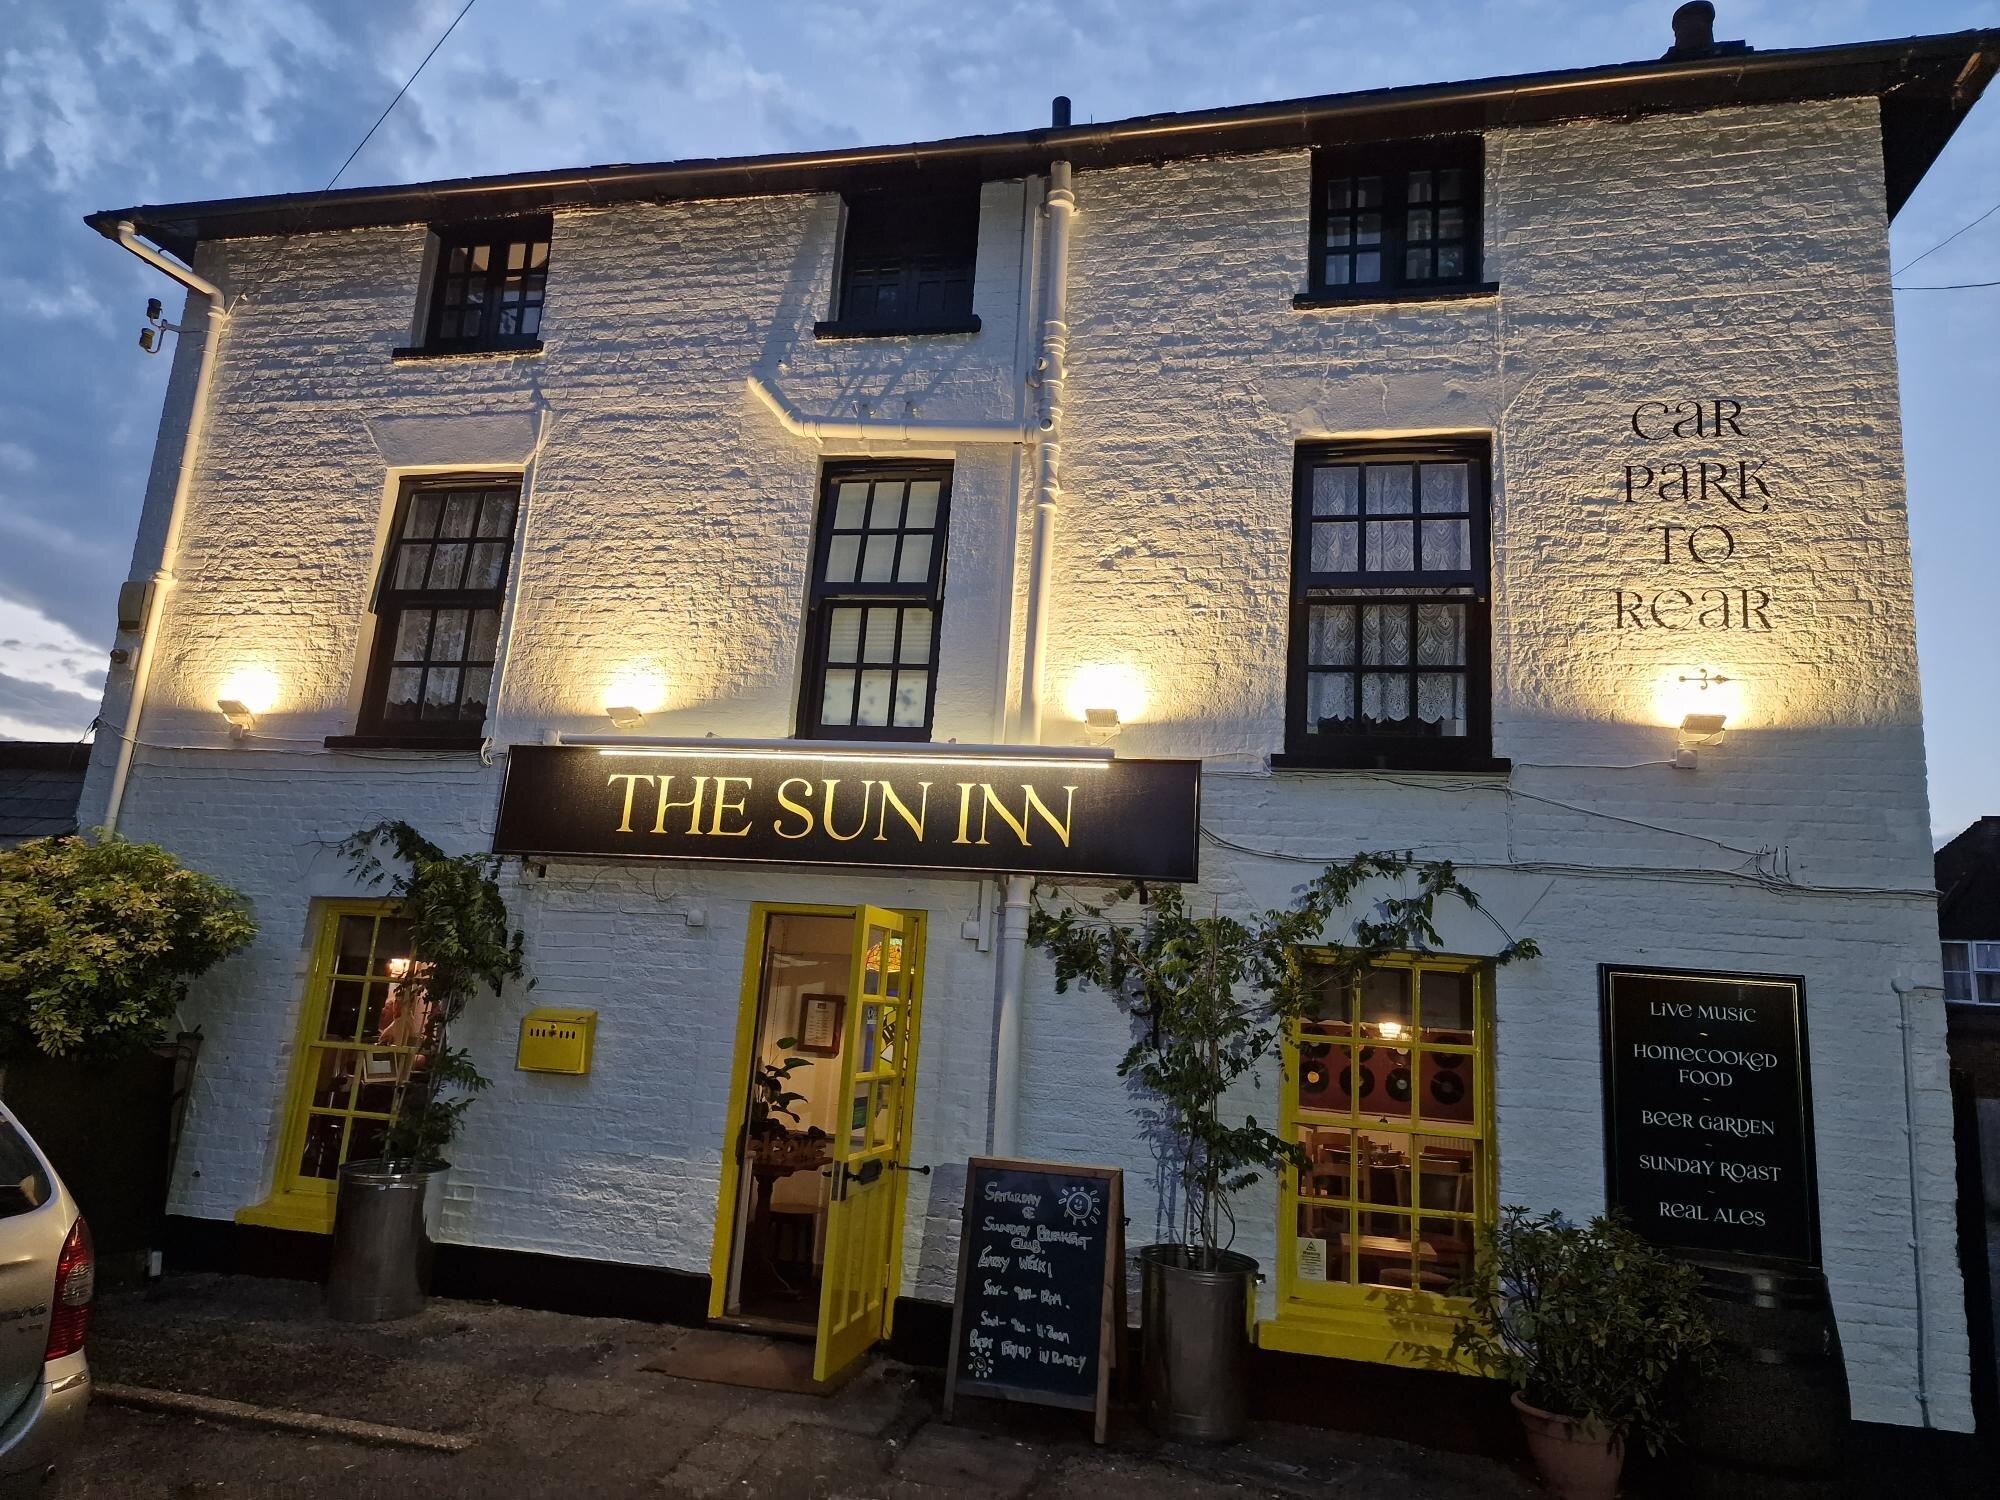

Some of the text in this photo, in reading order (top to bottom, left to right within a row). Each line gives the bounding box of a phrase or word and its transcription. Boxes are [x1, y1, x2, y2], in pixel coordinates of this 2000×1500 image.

[1648, 524, 1734, 565] TO
[607, 773, 1079, 848] THE SUN INN
[1679, 1069, 1733, 1087] FOOD
